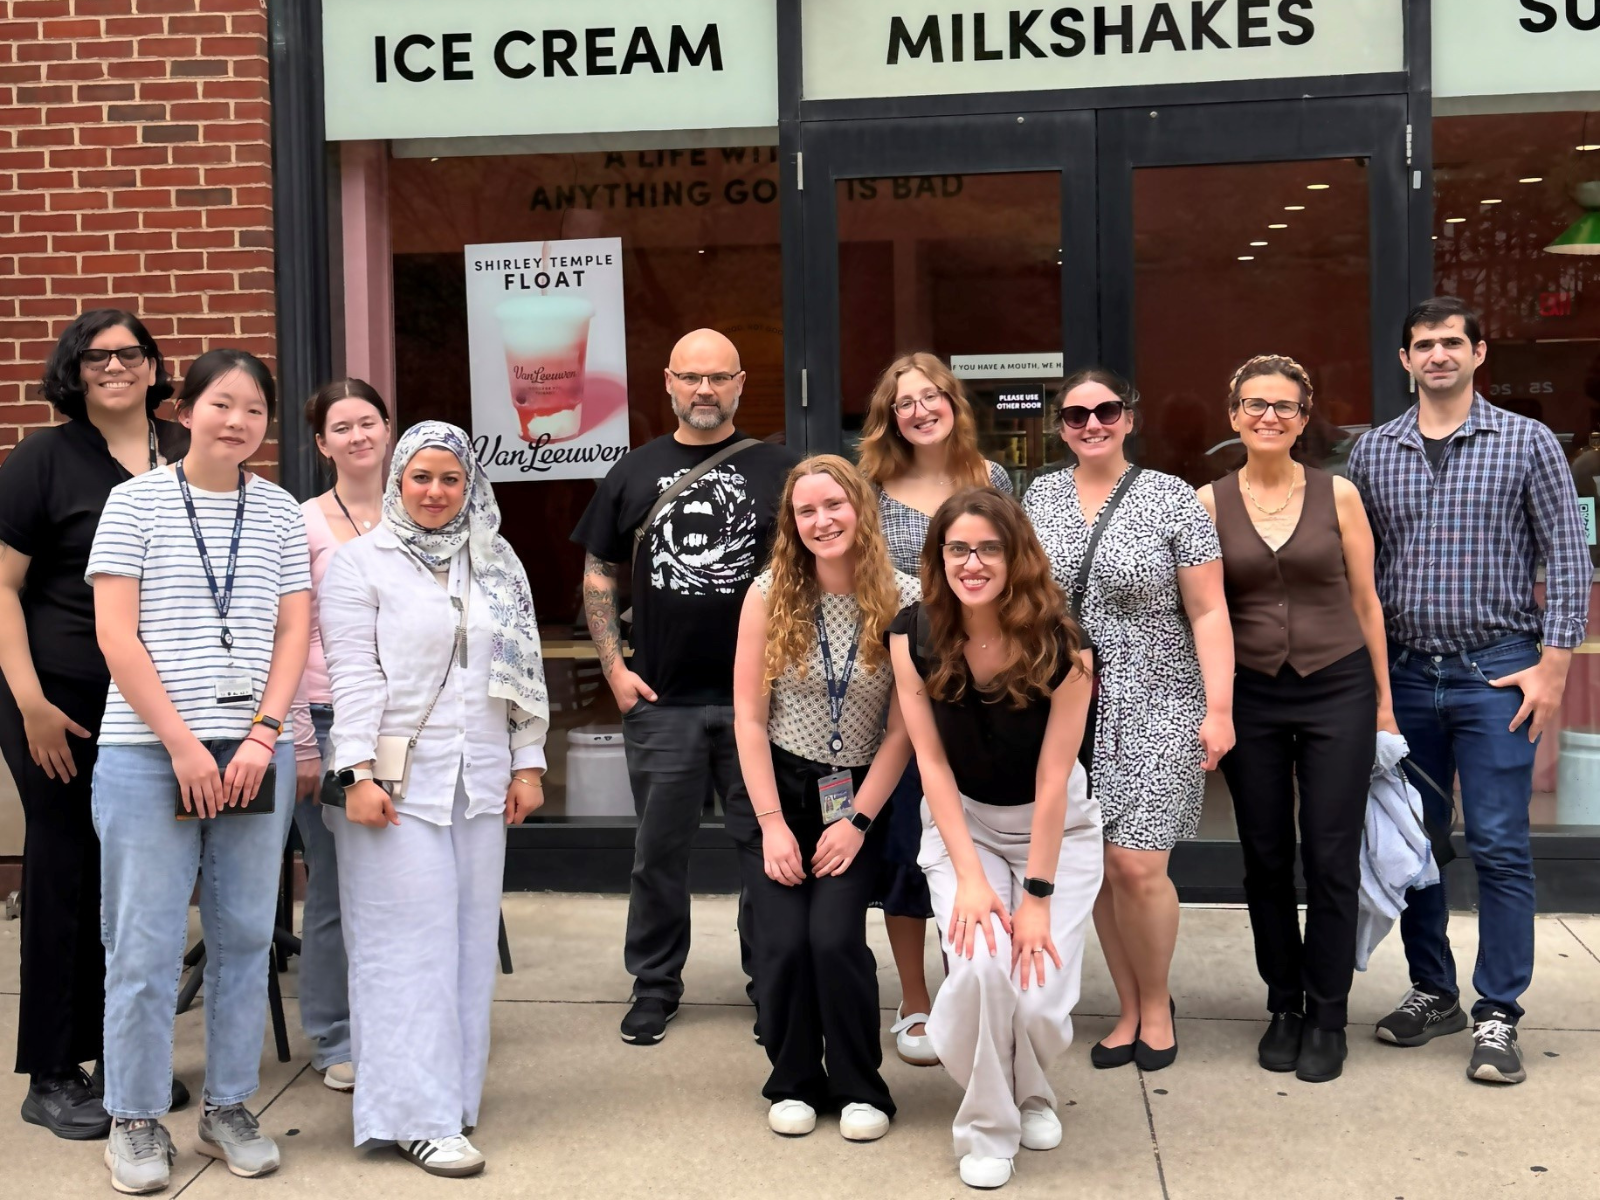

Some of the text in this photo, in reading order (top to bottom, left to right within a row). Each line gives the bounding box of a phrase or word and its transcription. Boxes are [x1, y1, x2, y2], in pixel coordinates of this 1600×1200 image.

[1519, 0, 1600, 33] SU
[886, 0, 1315, 65] MILKSHAKES
[374, 23, 724, 83] ICE CREAM
[638, 148, 708, 168] LIFE
[530, 180, 712, 211] ANYTHING
[893, 174, 963, 200] BAD
[474, 254, 613, 272] SHIRLEY TEMPLE
[504, 270, 586, 291] FLOAT
[977, 363, 998, 371] HAVE
[996, 402, 1020, 410] OTHER
[1025, 393, 1039, 401] USE
